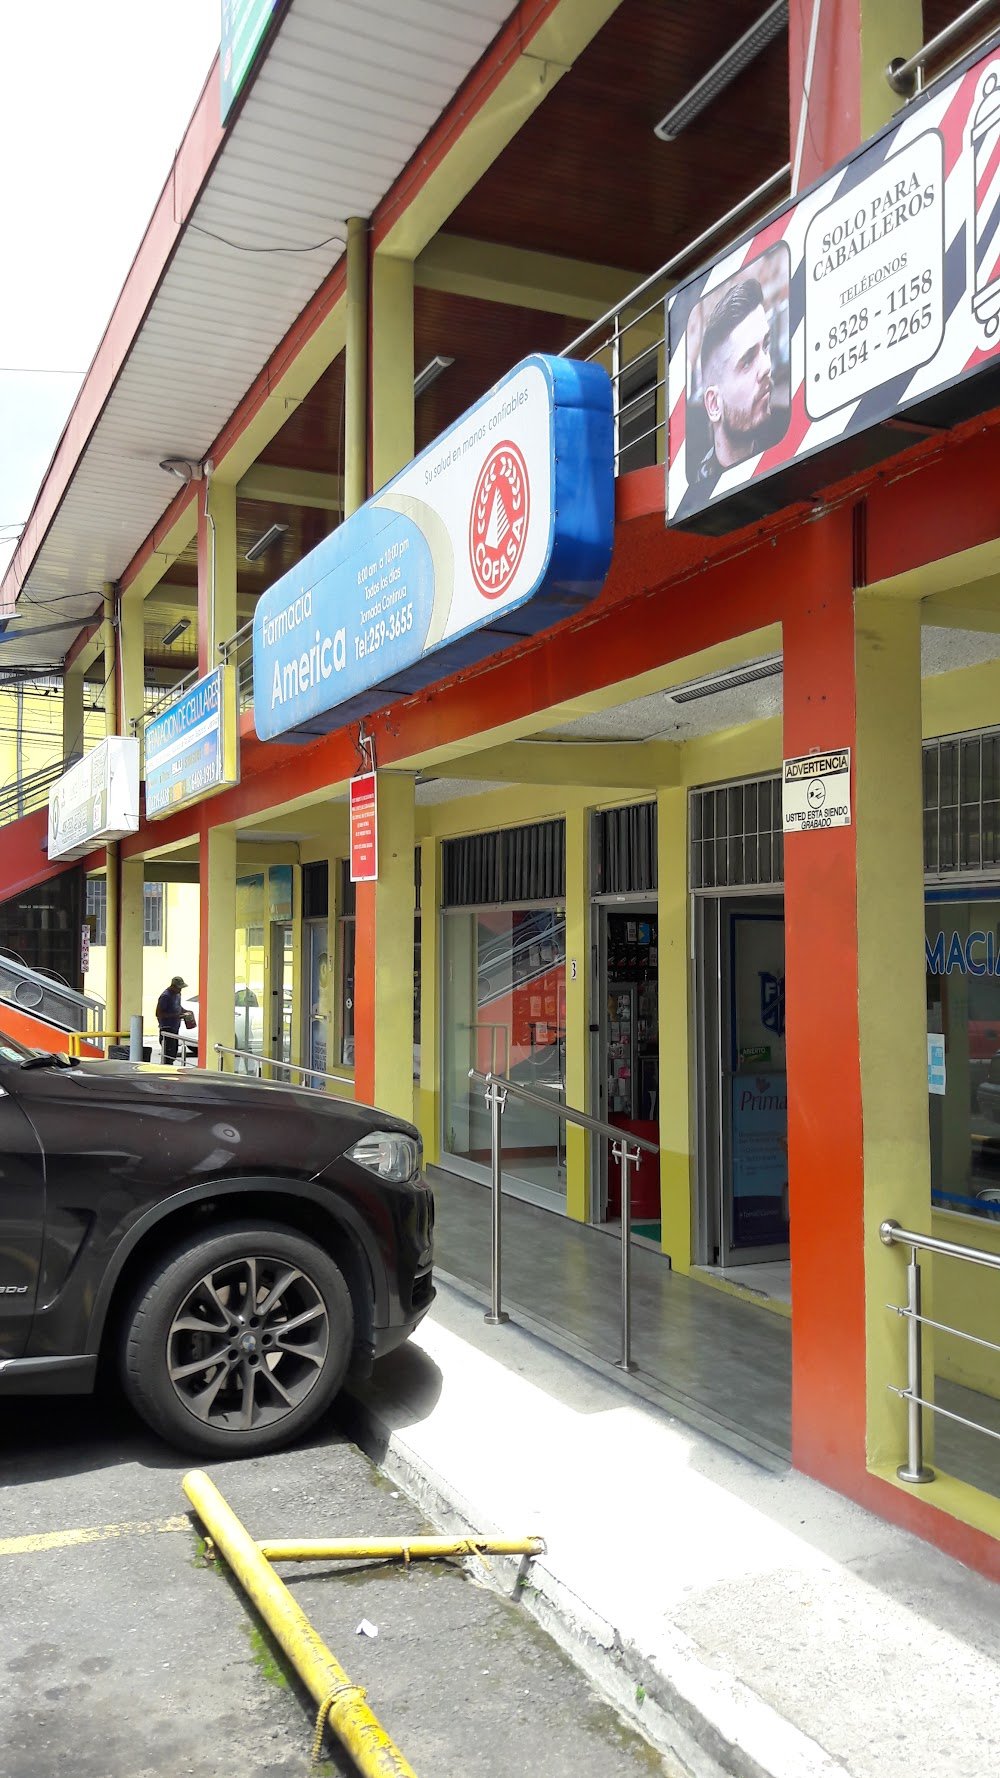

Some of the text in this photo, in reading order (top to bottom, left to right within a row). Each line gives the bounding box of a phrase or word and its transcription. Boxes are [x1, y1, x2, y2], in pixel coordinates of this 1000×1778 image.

[813, 184, 935, 283] CABALLEROS
[822, 172, 922, 254] SOLO PARA
[840, 252, 908, 307] TELÉFONOS
[828, 307, 869, 349] 8328
[887, 270, 933, 313] 1158
[828, 340, 869, 382] 6154
[886, 303, 932, 347] 2265
[424, 388, 529, 485] Su salud en manos confiables
[357, 538, 409, 585] 8:00 am a 10:00 pm
[476, 516, 524, 585] COFASA
[361, 600, 381, 625] Jornada
[365, 582, 380, 601] Todos
[380, 575, 388, 590] los
[262, 587, 312, 648] Farmacia
[354, 602, 413, 660] Tel:259-3655
[271, 627, 346, 710] America
[786, 755, 848, 777] ADVERTENCIA
[785, 805, 849, 823] USTED ESTA SIENDO
[801, 817, 832, 830] GRABADO
[926, 930, 1000, 977] MACI
